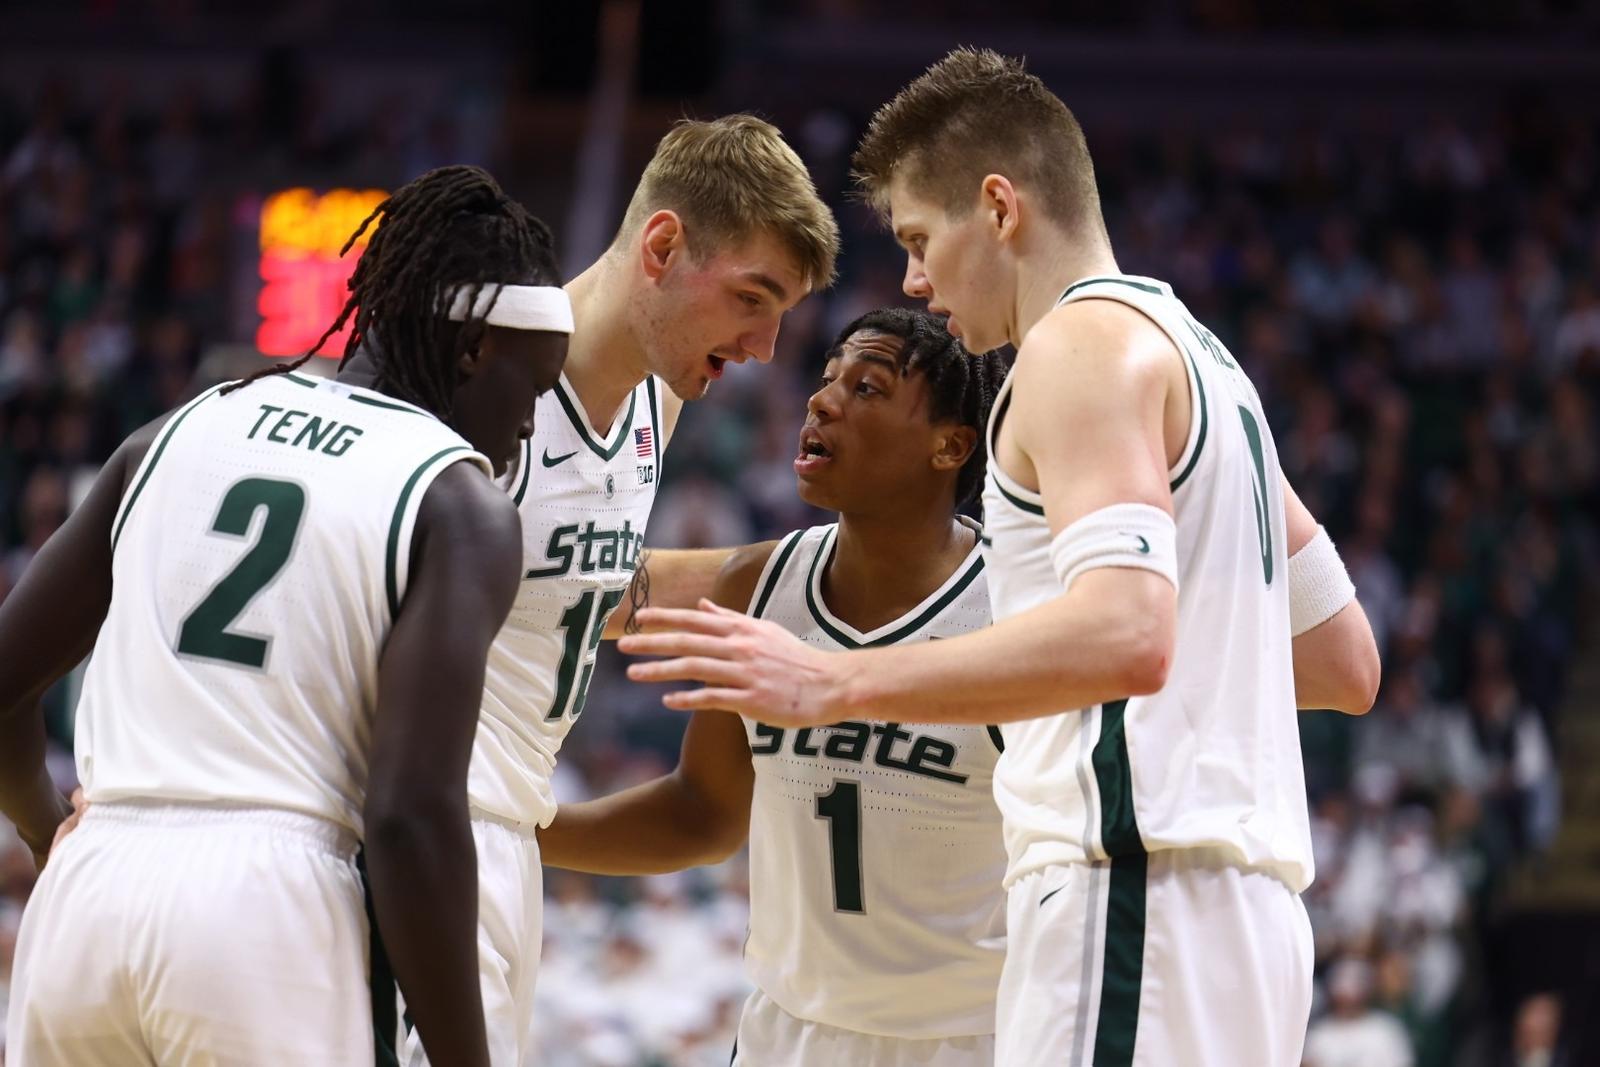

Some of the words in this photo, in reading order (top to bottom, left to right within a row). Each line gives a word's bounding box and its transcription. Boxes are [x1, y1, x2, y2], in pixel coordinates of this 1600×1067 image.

[246, 403, 364, 457] TENG
[176, 474, 308, 672] 2
[814, 778, 867, 916] 1
